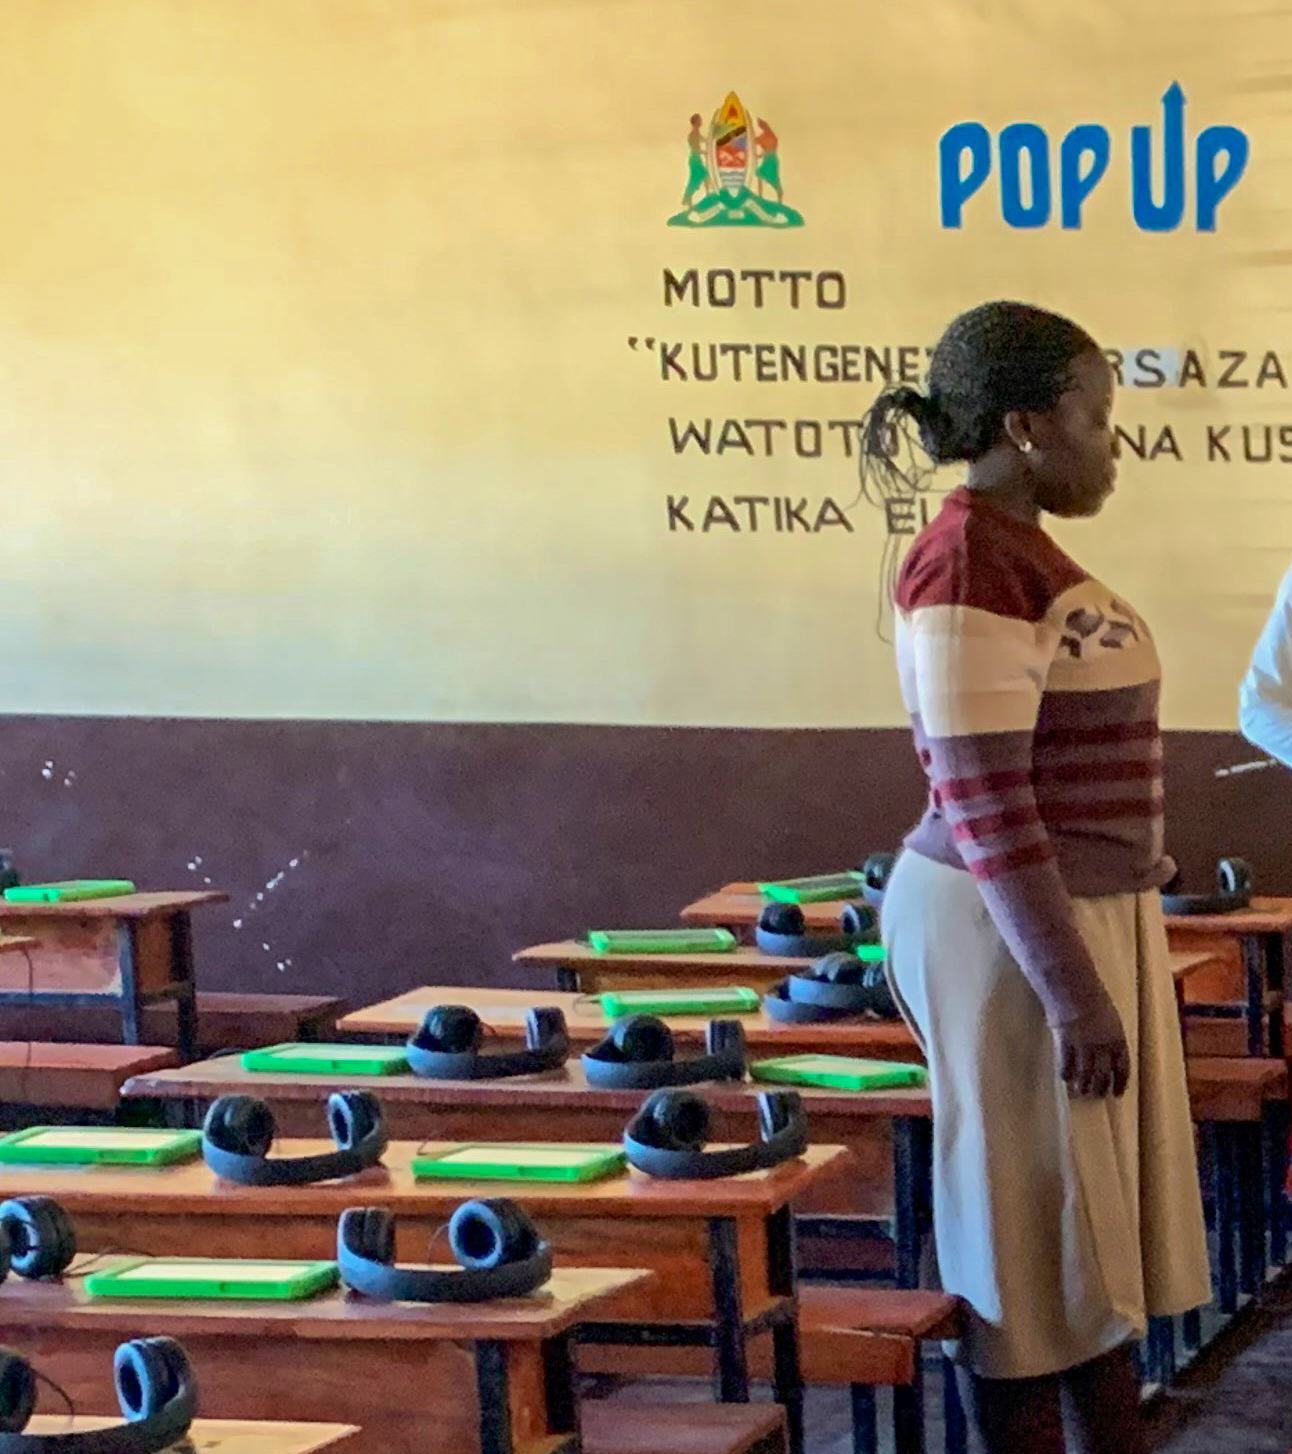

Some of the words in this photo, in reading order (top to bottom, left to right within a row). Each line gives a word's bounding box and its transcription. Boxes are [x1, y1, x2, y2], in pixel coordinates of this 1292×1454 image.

[939, 121, 1111, 230] POP
[1131, 80, 1250, 233] UP
[662, 267, 846, 309] MOTTO
[627, 336, 935, 384] “KUTENGENE
[666, 495, 854, 533] KATIKA
